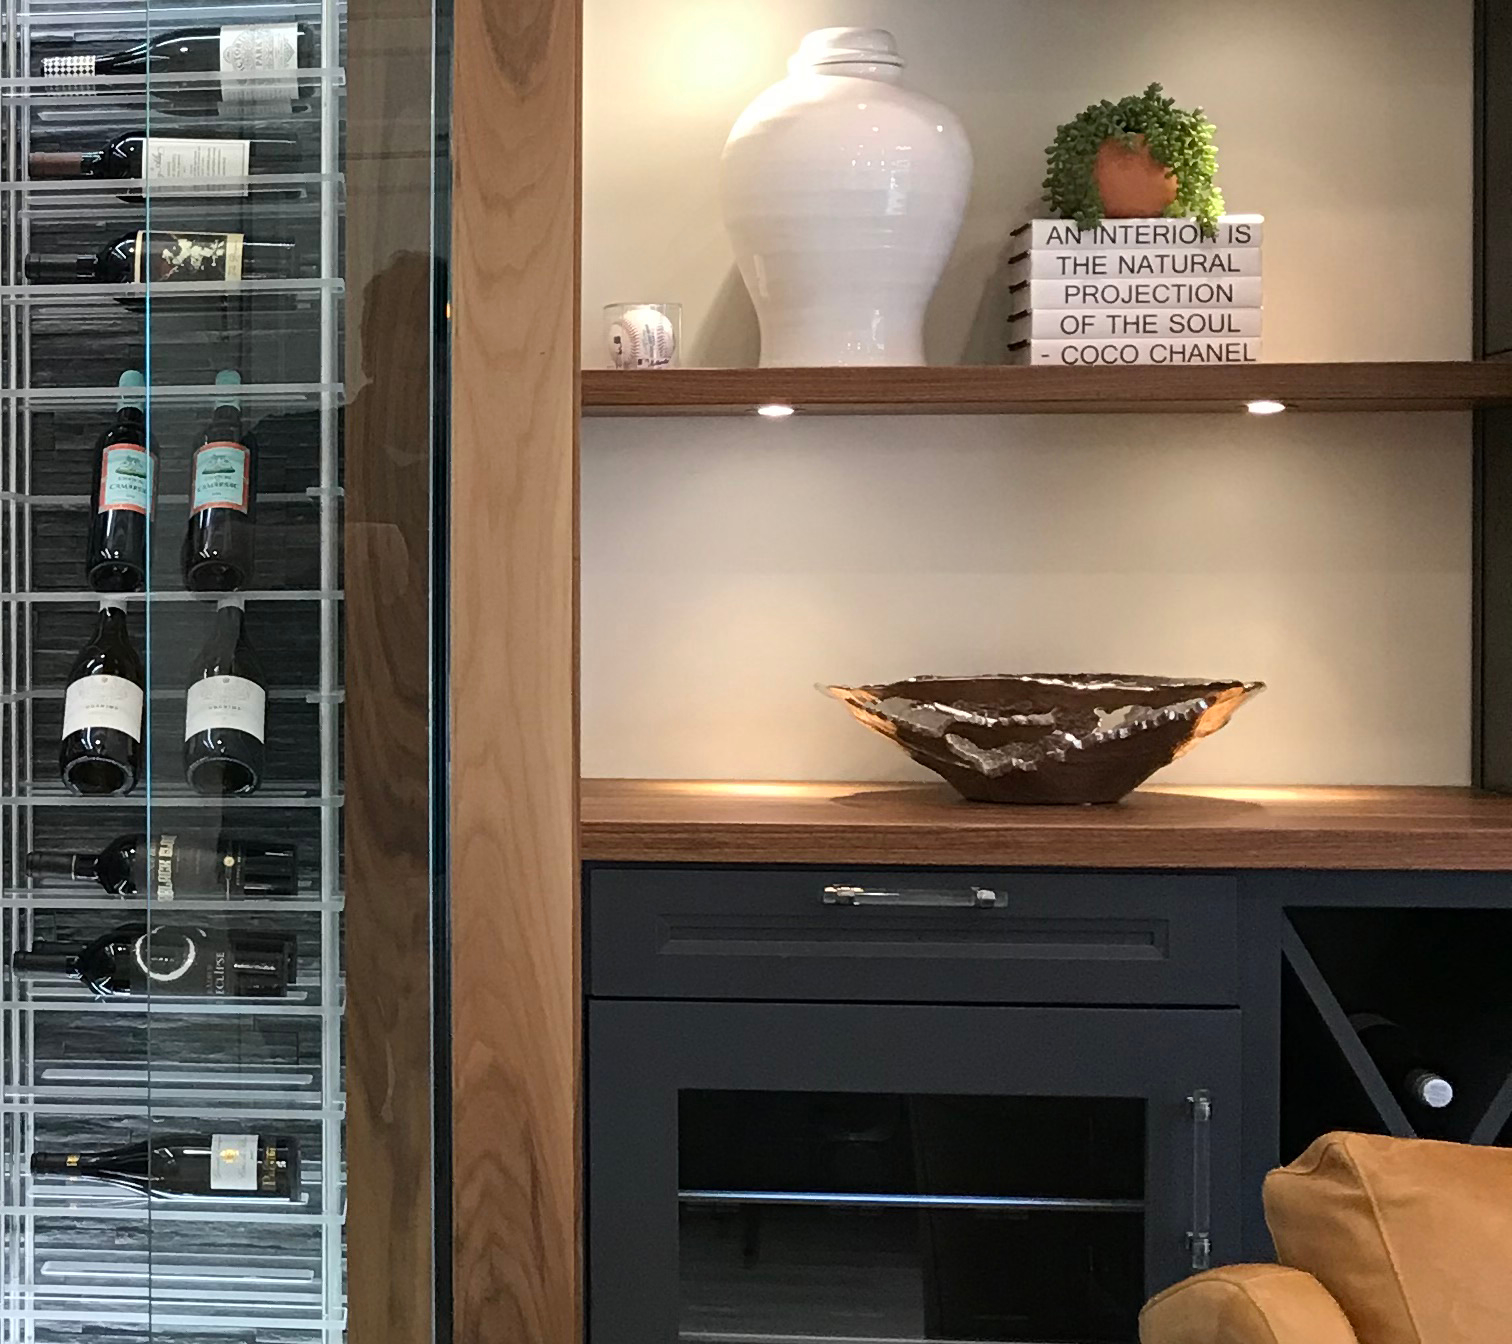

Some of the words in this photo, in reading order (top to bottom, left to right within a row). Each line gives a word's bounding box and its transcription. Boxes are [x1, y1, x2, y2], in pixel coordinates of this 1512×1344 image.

[1046, 225, 1082, 245] AN
[1093, 224, 1216, 244] INTERIOR
[1228, 224, 1252, 244] IS
[1057, 255, 1107, 275] THE
[1119, 253, 1240, 274] NATURAL
[1065, 283, 1233, 304] PROJECTION
[1060, 314, 1095, 334] OF
[1107, 314, 1158, 334] THE
[1169, 313, 1241, 333] SOUL
[1061, 344, 1139, 364] COCO
[1150, 342, 1257, 362] CHANEL
